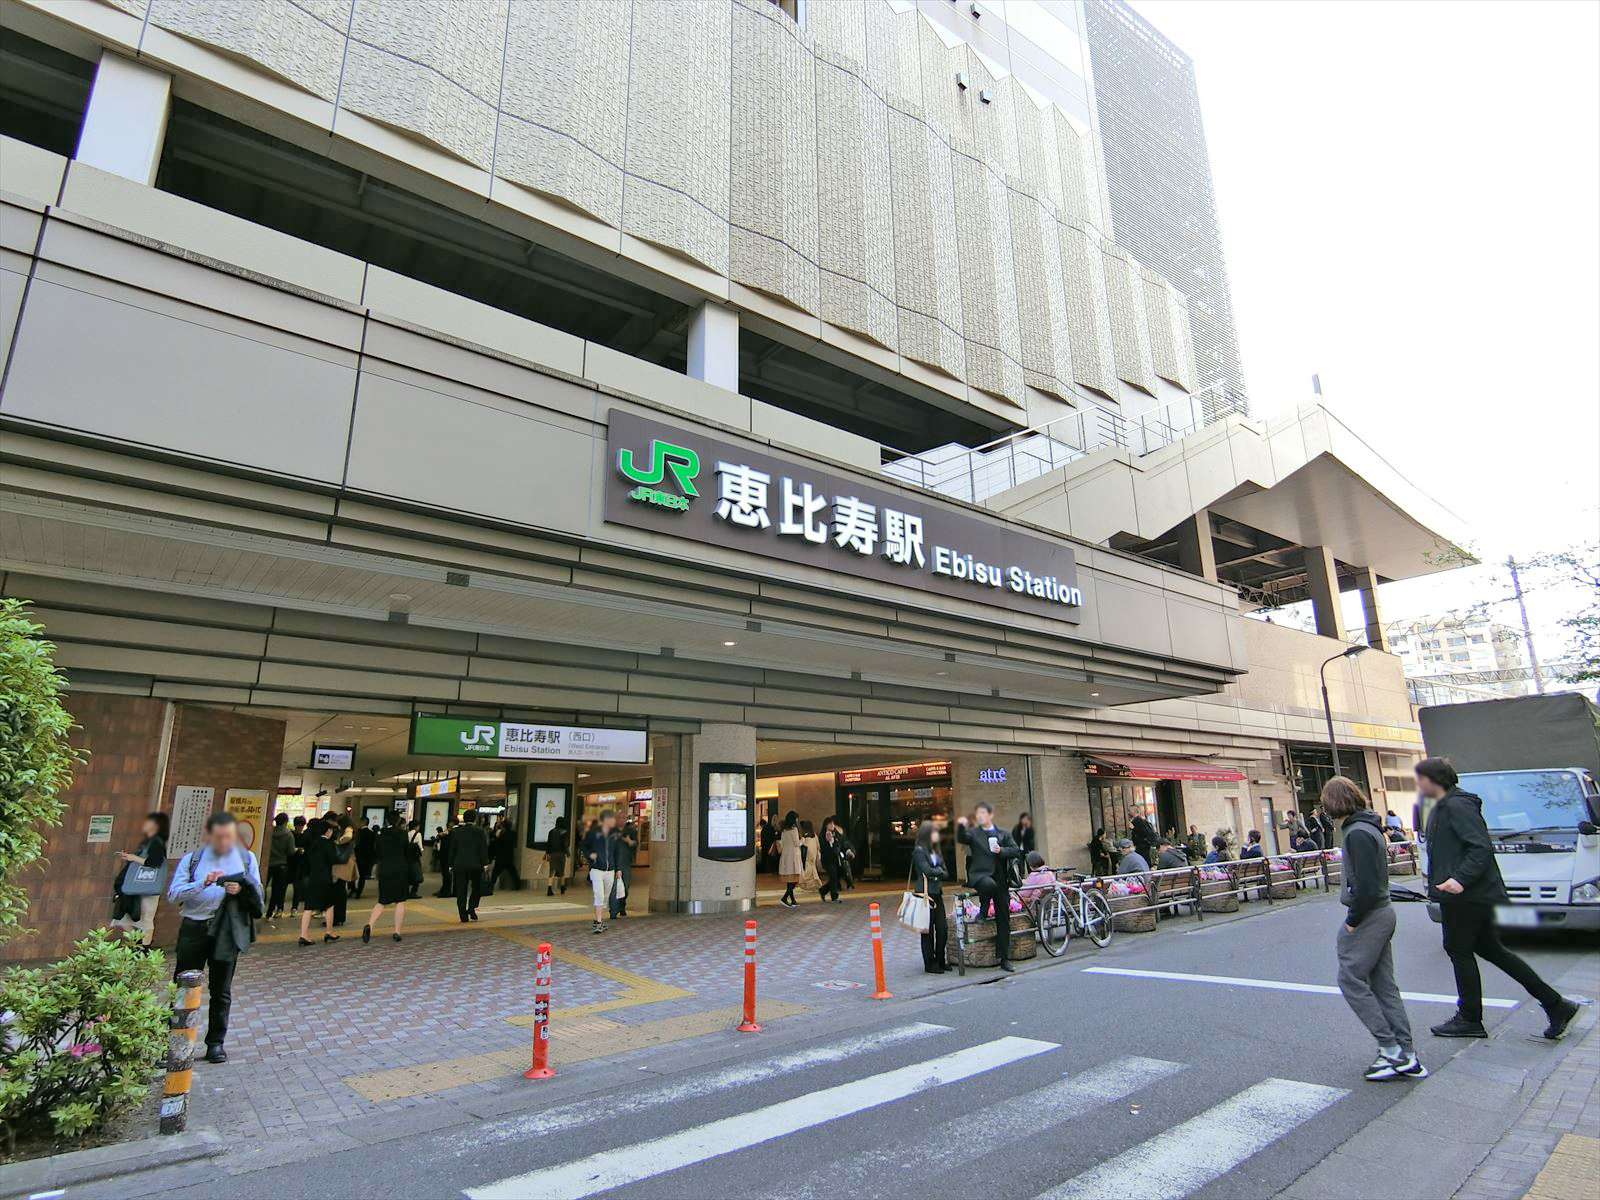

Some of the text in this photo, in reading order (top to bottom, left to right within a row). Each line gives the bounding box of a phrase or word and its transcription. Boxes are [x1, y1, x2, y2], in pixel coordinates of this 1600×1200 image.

[617, 439, 700, 496] JR
[629, 486, 690, 511] JR東日本
[713, 460, 926, 569] 恵比寿駅
[932, 546, 1082, 607] Ebisu Station
[460, 725, 495, 745] JR
[506, 728, 561, 744] 恵比寿駅
[504, 744, 561, 755] Ebisu Station
[980, 767, 1006, 780] atré
[137, 869, 155, 880] Lee
